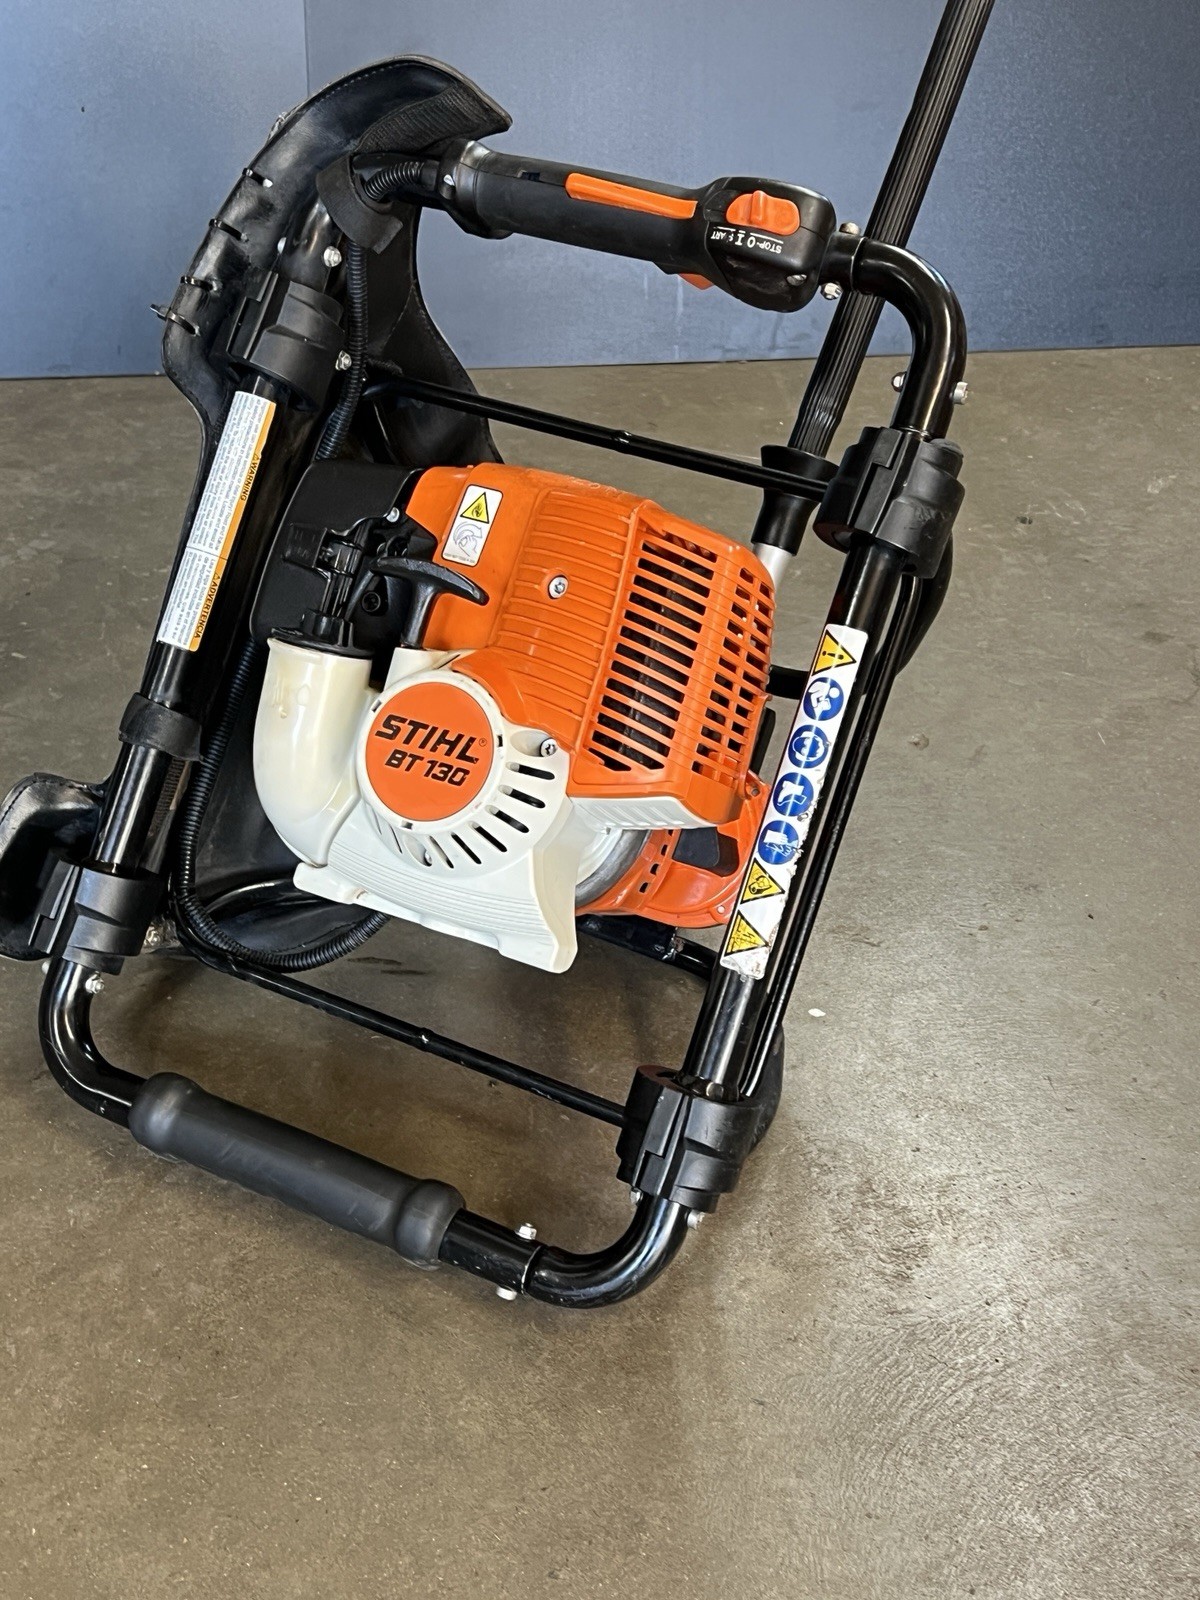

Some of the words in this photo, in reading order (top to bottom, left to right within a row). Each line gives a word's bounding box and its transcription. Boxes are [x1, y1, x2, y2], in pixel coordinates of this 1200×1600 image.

[239, 461, 257, 501] WARNING
[194, 580, 218, 639] ADVERTENCIA
[385, 749, 425, 772] BT
[424, 760, 471, 787] 130
